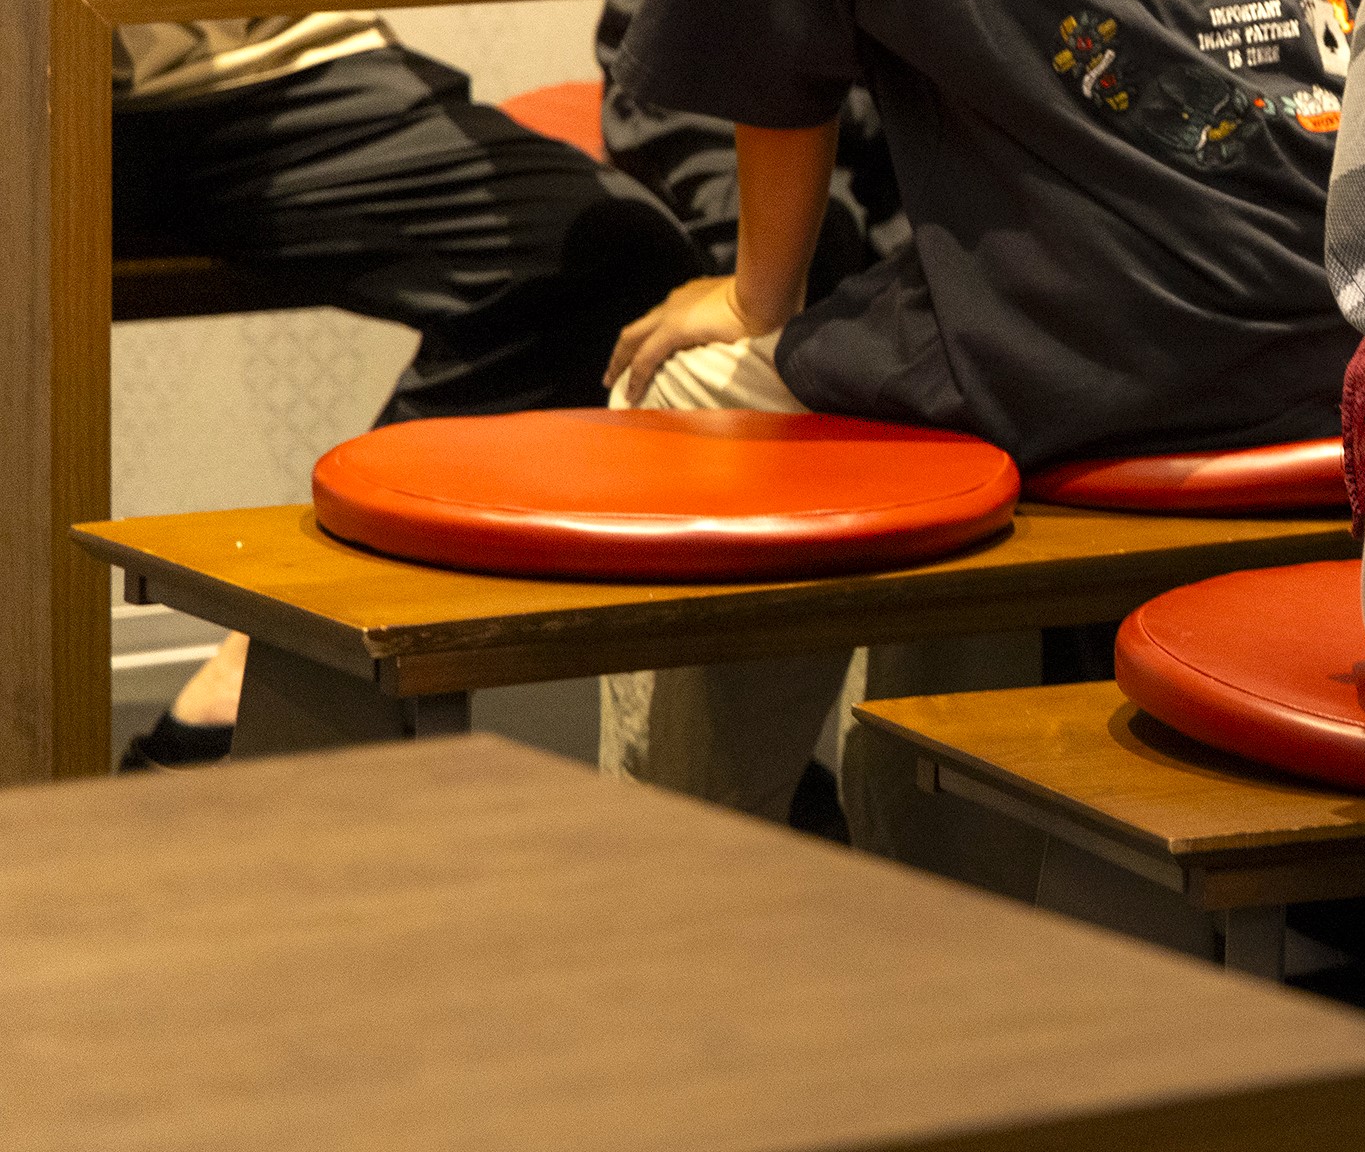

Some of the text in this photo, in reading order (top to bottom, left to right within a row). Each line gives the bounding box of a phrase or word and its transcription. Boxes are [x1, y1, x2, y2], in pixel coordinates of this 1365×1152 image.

[1209, 0, 1282, 27] IMPORTANT
[1198, 19, 1300, 51] IMAGE PATTERN
[1227, 49, 1243, 69] IS
